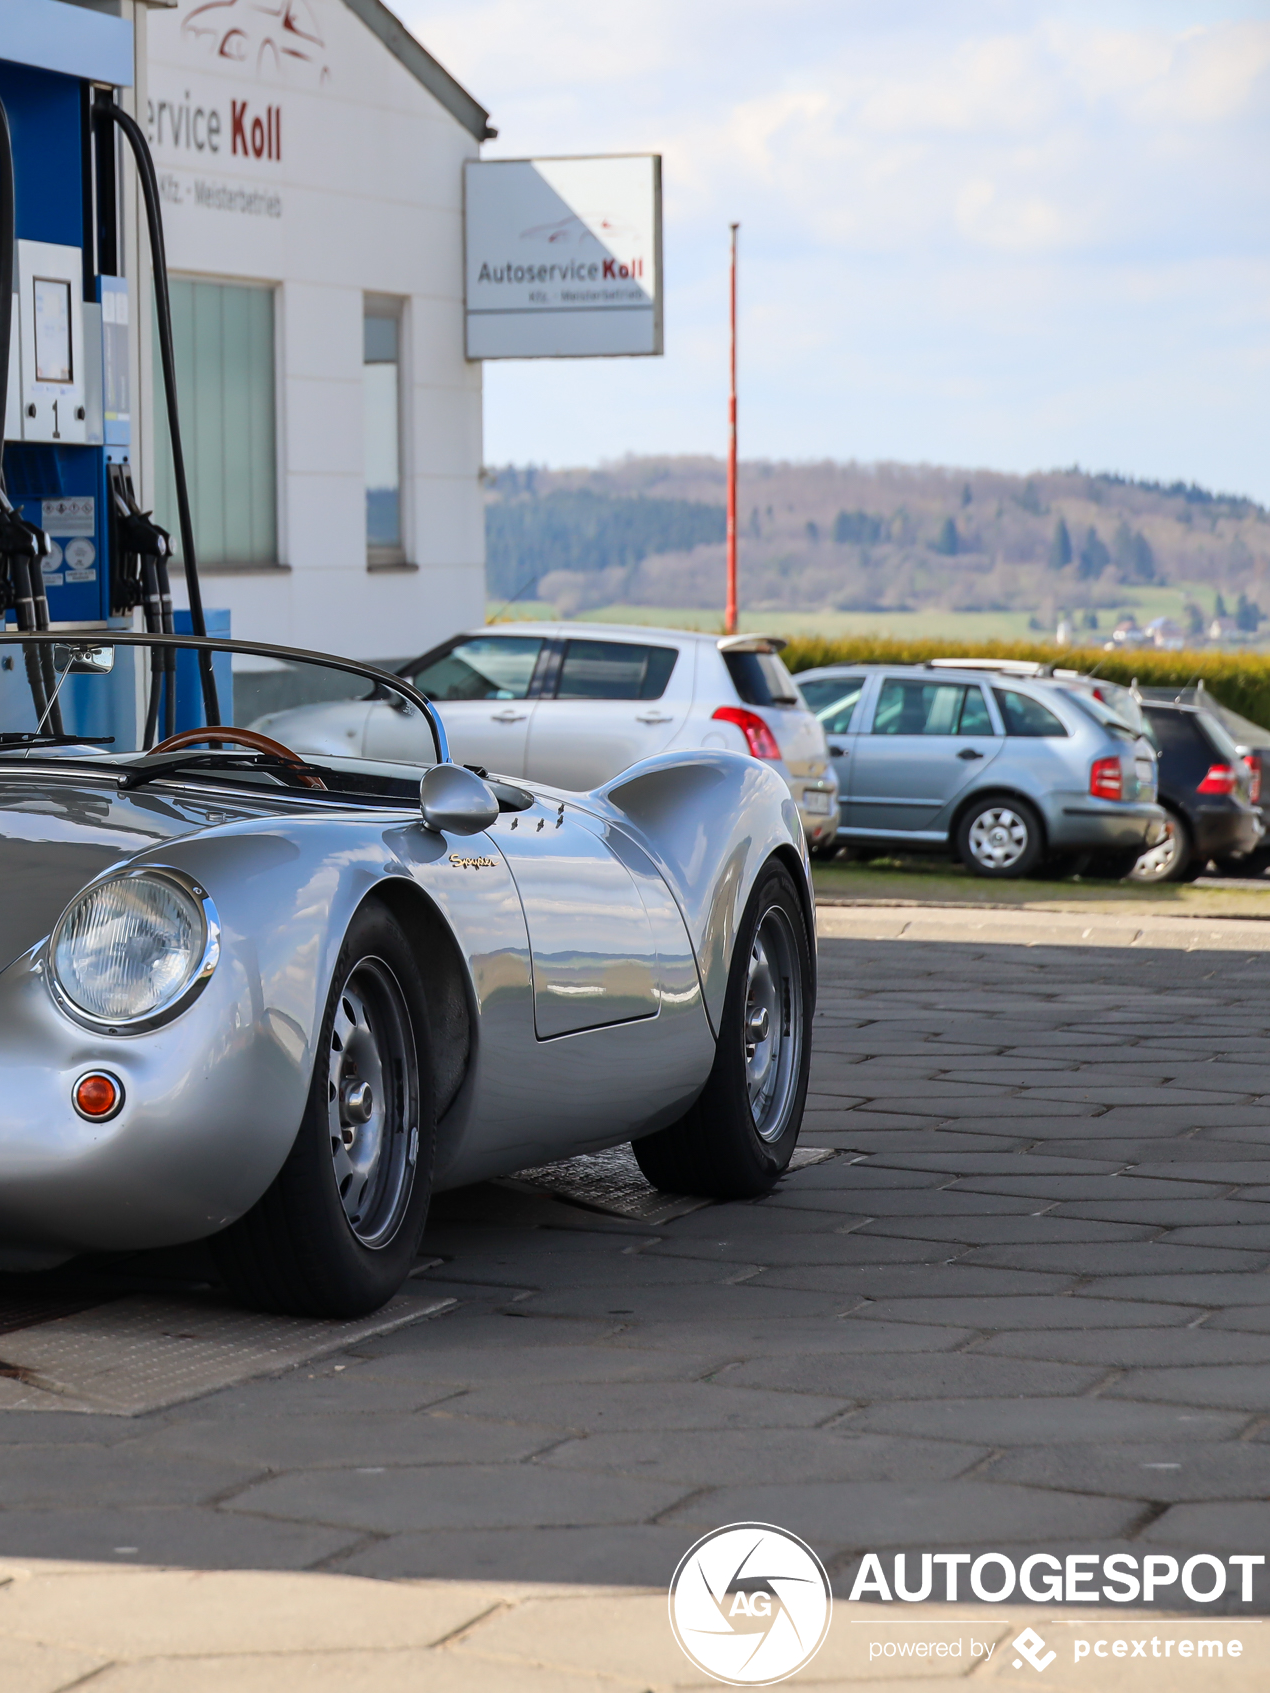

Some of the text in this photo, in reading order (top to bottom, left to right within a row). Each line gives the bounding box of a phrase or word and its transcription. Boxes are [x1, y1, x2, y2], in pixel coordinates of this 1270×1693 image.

[231, 99, 281, 161] Koll
[194, 180, 282, 218] Meisterbetrieb
[478, 258, 643, 284] Autoservice Koll
[561, 288, 643, 303] Meisterbetrieb
[51, 399, 61, 439] 1
[449, 854, 499, 870] Spyder
